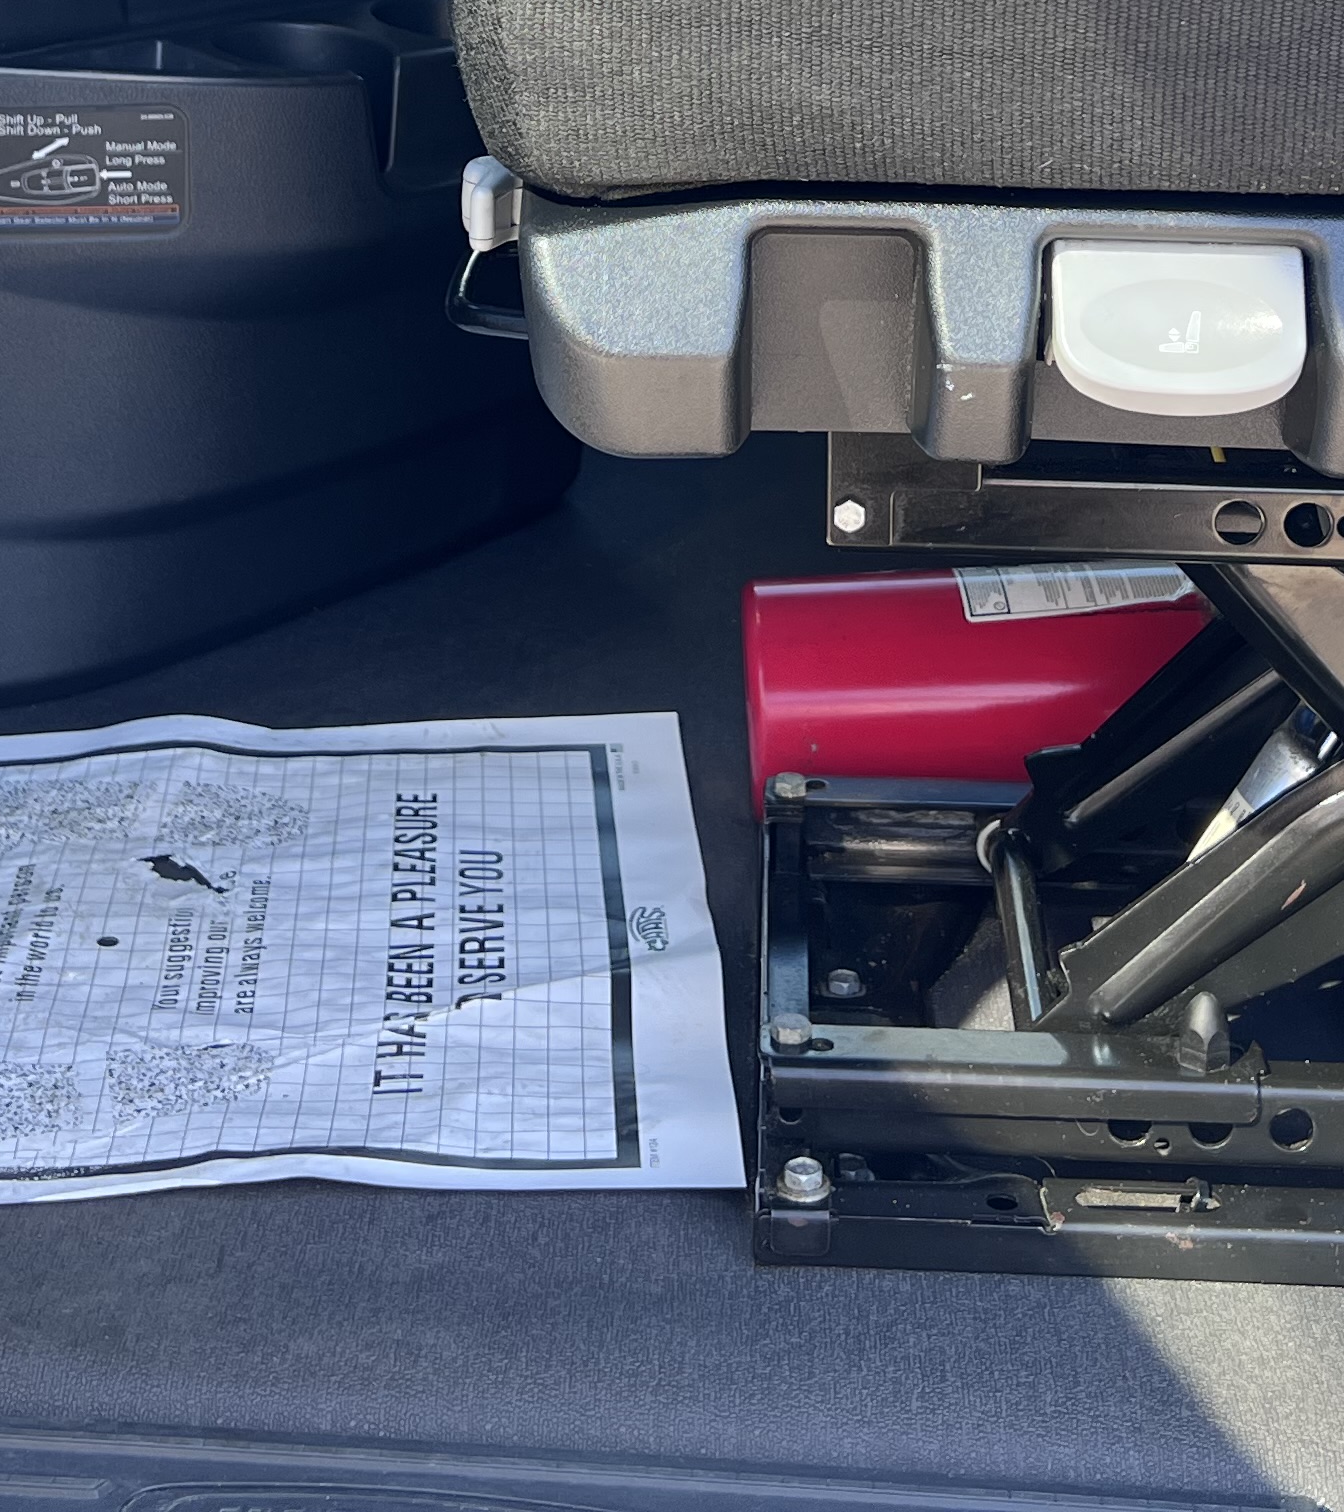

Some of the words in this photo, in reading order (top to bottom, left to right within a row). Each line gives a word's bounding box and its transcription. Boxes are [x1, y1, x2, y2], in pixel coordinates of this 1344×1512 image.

[28, 115, 46, 126] Up
[56, 114, 78, 125] Pull
[28, 125, 61, 136] Down
[72, 125, 102, 136] Push
[106, 141, 144, 151] Manual
[147, 140, 177, 151] Mode
[106, 155, 132, 167] Long
[135, 155, 166, 166] Press
[108, 181, 133, 191] Auto
[136, 180, 168, 191] Mode
[108, 193, 139, 204] Short
[142, 193, 173, 204] Press
[391, 793, 438, 903] PLEASURE
[8, 864, 36, 905] person
[459, 849, 504, 897] YOU
[43, 883, 65, 903] us.
[243, 875, 272, 933] welcome.
[34, 906, 58, 917] to
[390, 912, 435, 931] A
[26, 920, 54, 961] world
[207, 920, 229, 941] our
[457, 904, 506, 983] SERVE
[234, 937, 267, 986] always
[14, 965, 42, 987] the
[191, 946, 230, 1015] improving
[386, 944, 435, 1004] BEEN
[8, 990, 36, 1002] in
[151, 984, 181, 1011] Your
[234, 990, 255, 1014] are
[376, 1012, 429, 1058] HAS
[373, 1070, 423, 1095] IT
